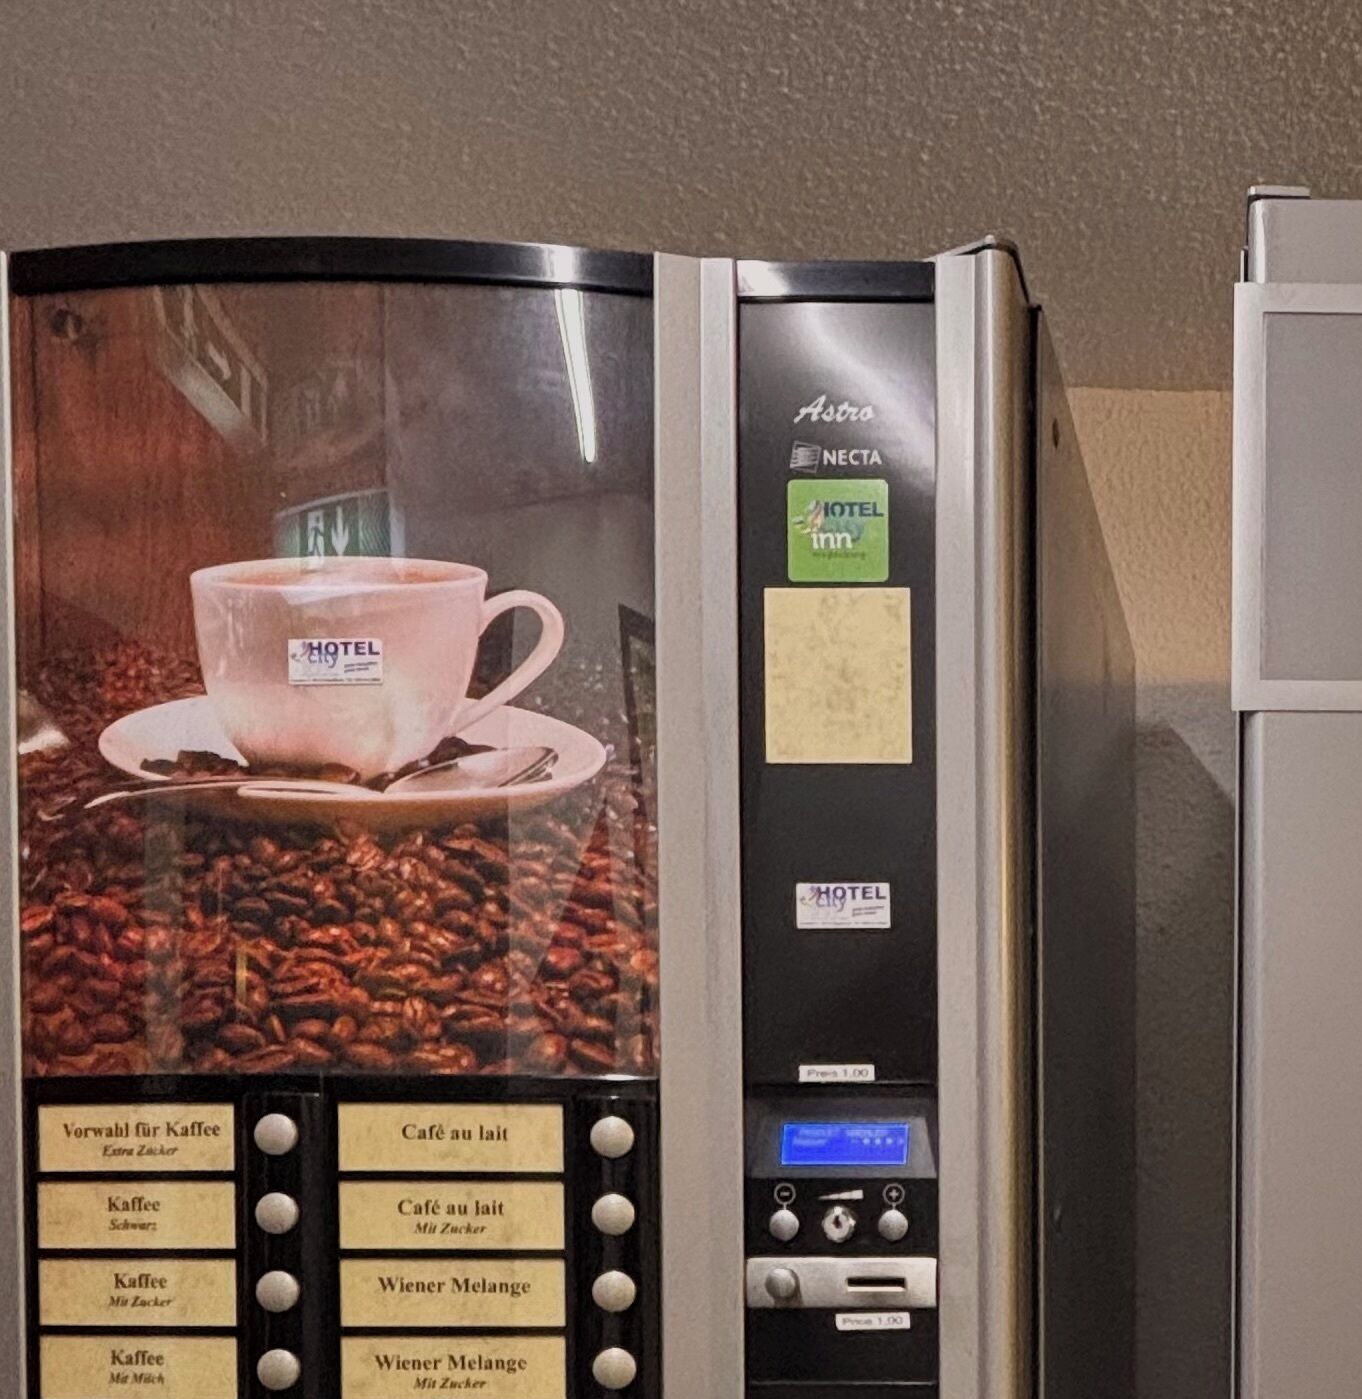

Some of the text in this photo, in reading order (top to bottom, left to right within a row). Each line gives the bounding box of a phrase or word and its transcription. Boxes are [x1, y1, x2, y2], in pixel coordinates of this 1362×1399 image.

[794, 395, 875, 424] Astro
[823, 449, 883, 467] NECTA
[811, 532, 853, 550] inn
[308, 641, 381, 656] HOTEL
[817, 886, 887, 900] HOTEL
[63, 1121, 221, 1138] Vorwahl für Kaffee
[401, 1122, 509, 1142] Café au lait
[136, 1144, 178, 1158] Zucker
[107, 1197, 161, 1213] Kaffee
[397, 1198, 505, 1218] Café au lait
[415, 1222, 487, 1236] Mit Zucker
[113, 1273, 168, 1290] Kaffee
[378, 1276, 531, 1299] Wiener Melange
[110, 1350, 165, 1368] Kaffee
[374, 1353, 527, 1376] Wiener Melange
[414, 1377, 486, 1391] Mit Zucker
